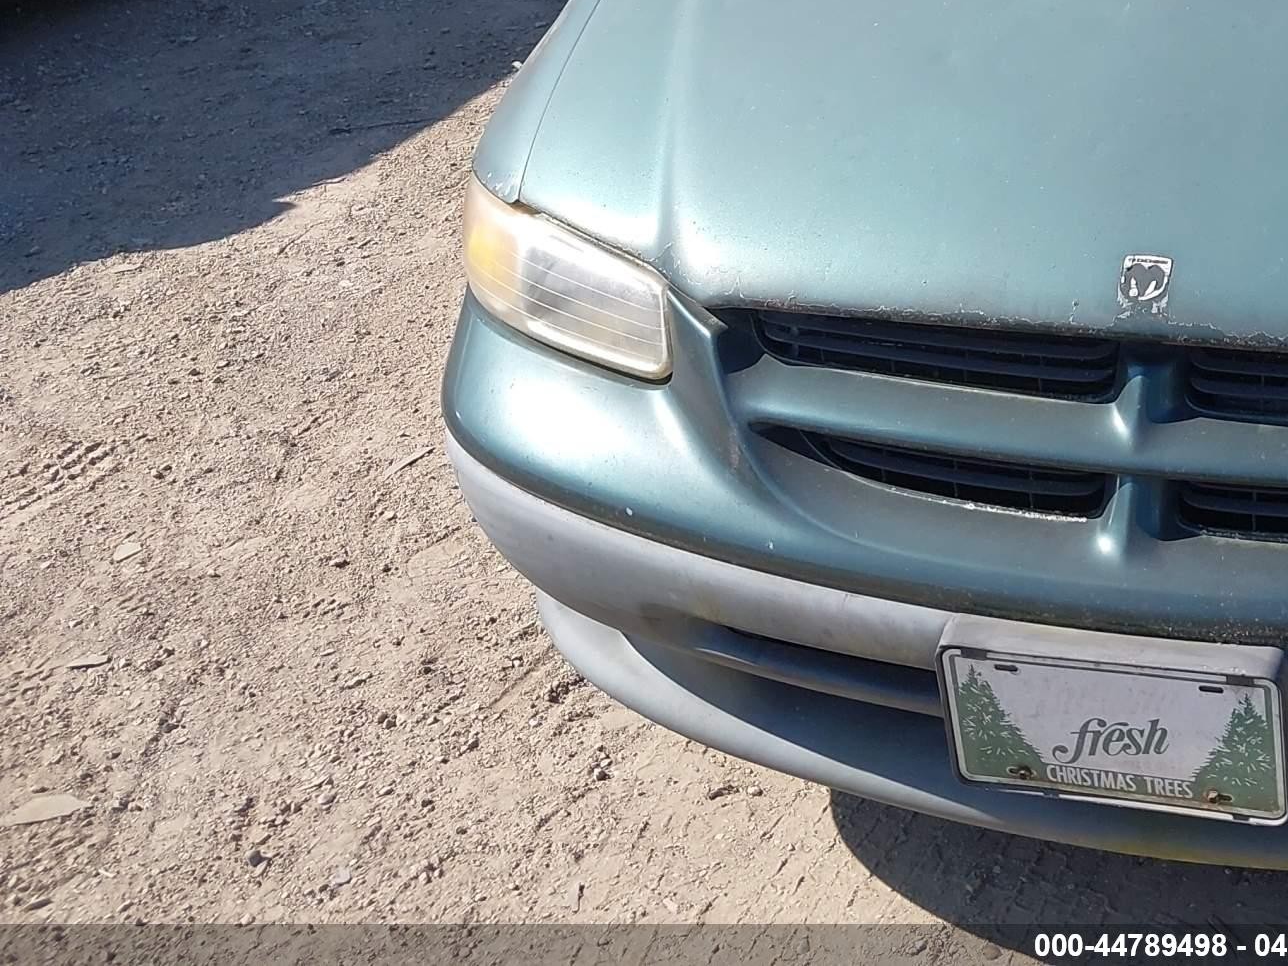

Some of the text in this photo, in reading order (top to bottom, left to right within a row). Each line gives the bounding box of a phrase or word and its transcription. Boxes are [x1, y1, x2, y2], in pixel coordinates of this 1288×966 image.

[1052, 717, 1169, 764] fresh
[1046, 764, 1193, 799] CHRISTMAS TREES
